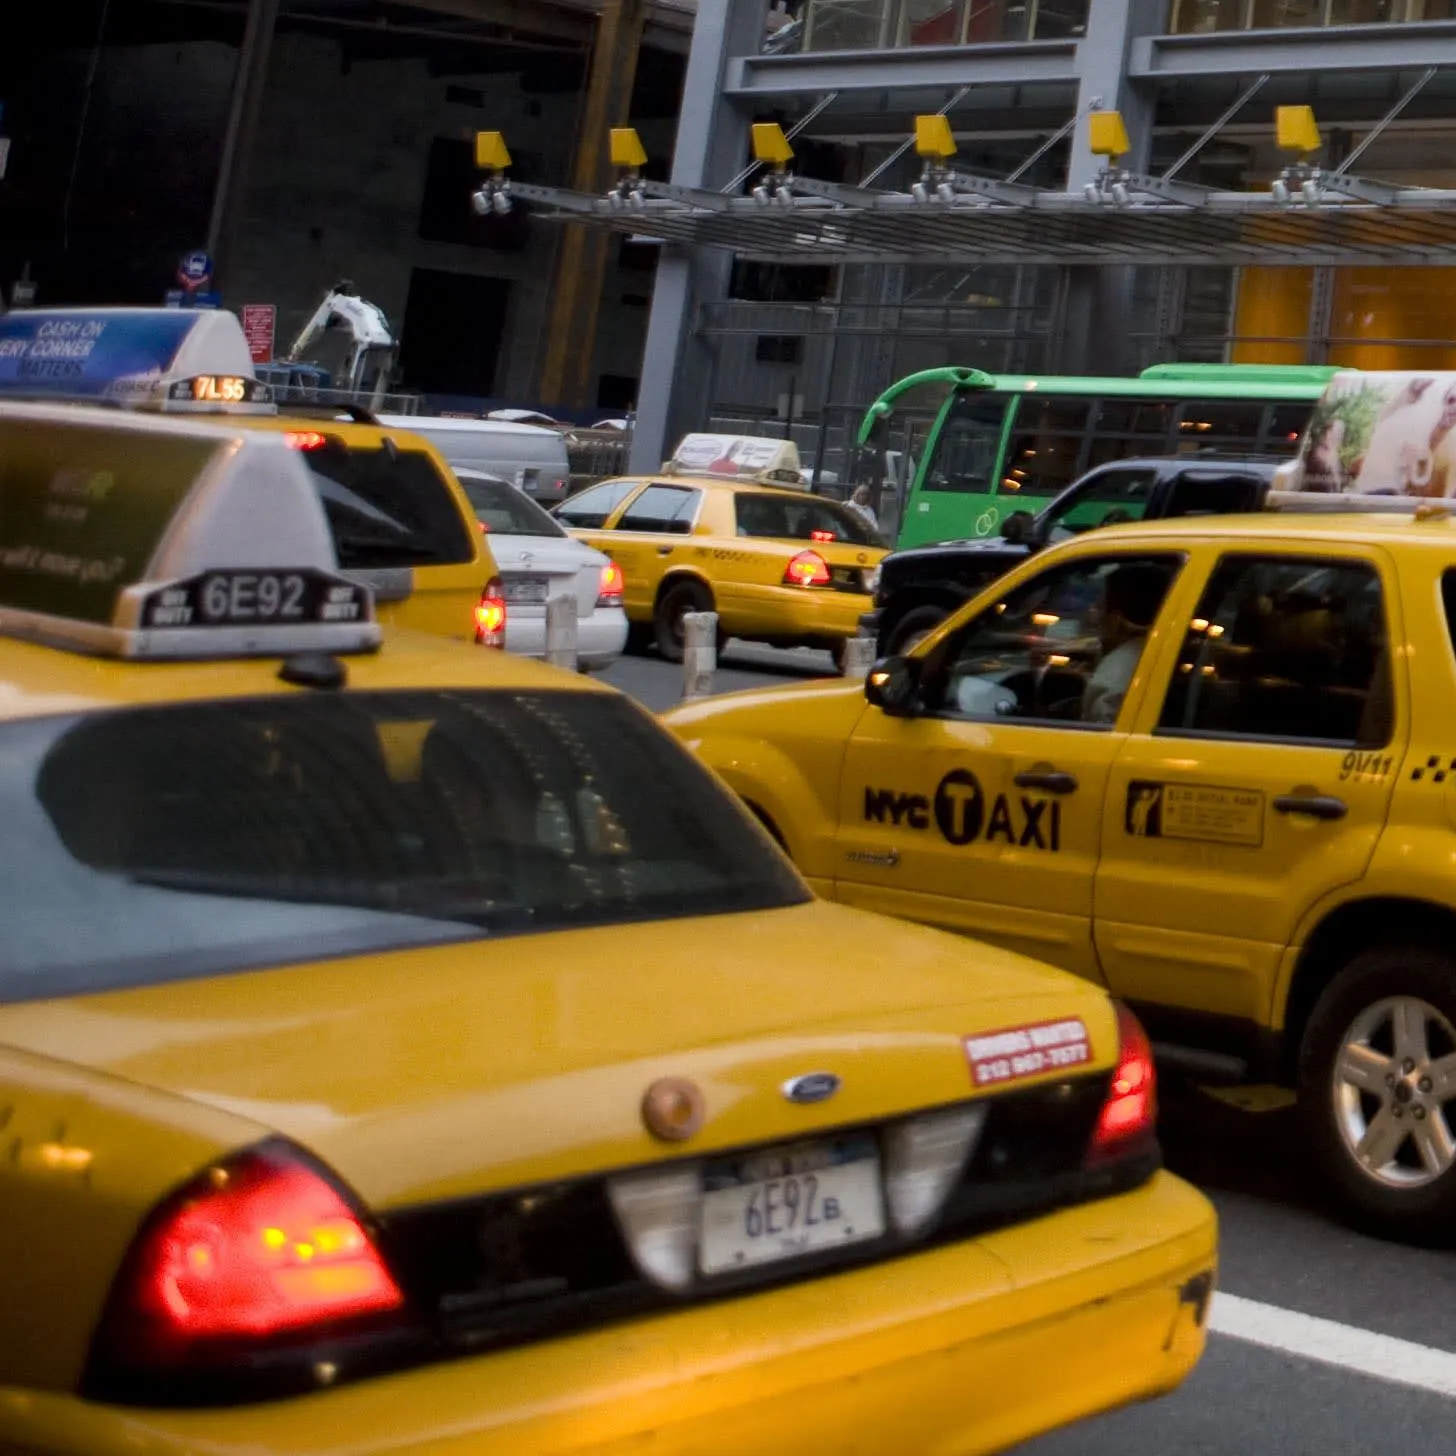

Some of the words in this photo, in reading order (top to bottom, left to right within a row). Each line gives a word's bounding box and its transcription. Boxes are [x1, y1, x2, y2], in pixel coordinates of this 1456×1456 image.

[30, 340, 96, 357] CORNER
[197, 377, 245, 401] 7L55
[203, 575, 305, 617] 6E92
[863, 785, 930, 830] NYC
[934, 768, 1061, 852] TAXI
